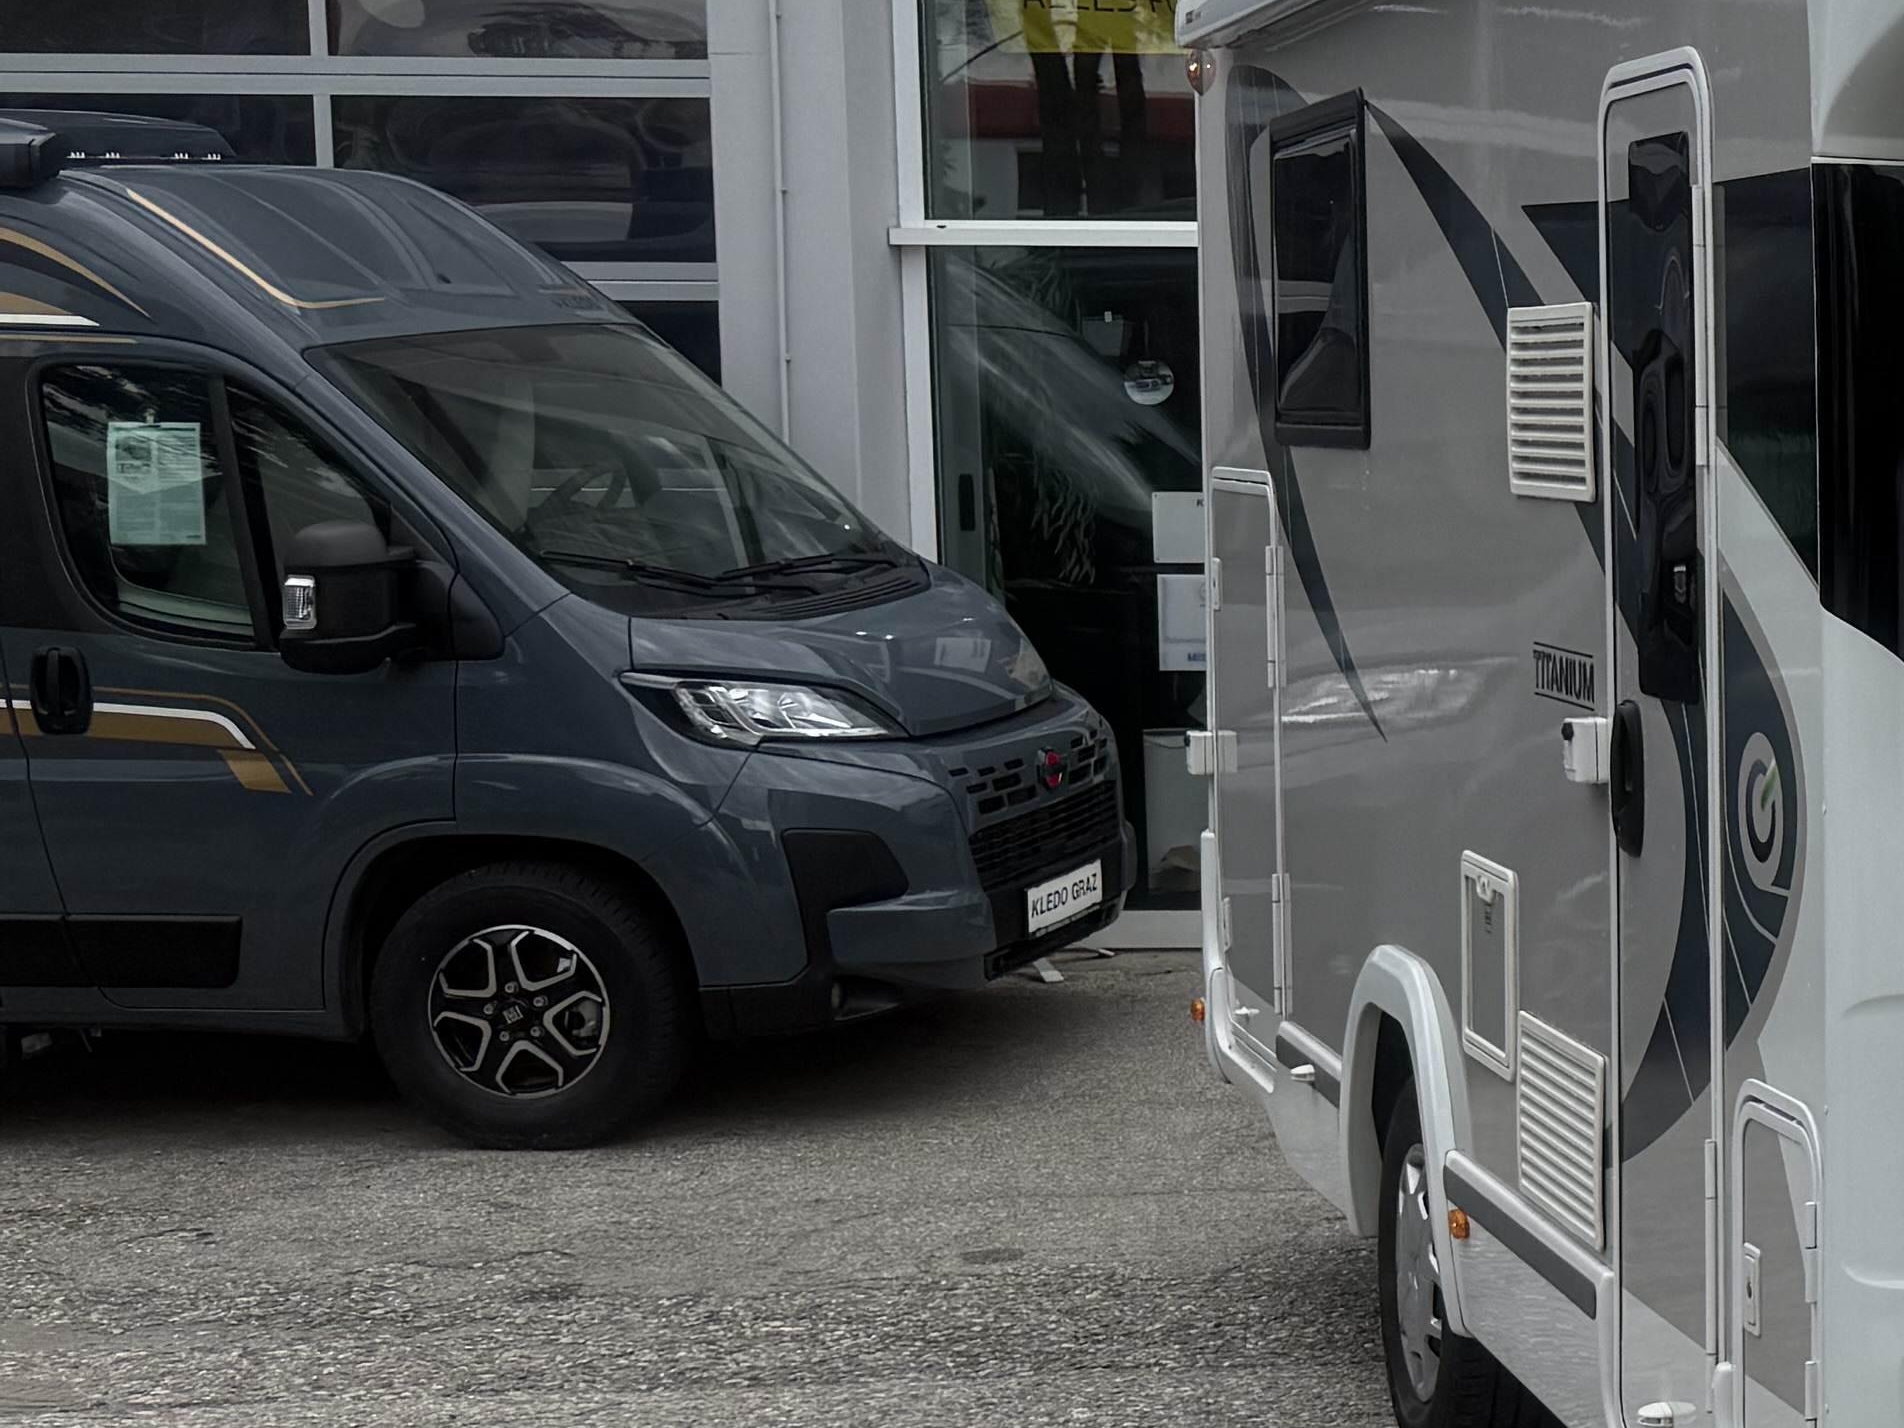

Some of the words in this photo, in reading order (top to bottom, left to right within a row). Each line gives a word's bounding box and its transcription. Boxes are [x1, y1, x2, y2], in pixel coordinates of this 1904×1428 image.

[1533, 649, 1595, 704] TITANIUM
[1031, 886, 1068, 918] KLEDO
[1072, 872, 1097, 901] GRAZ
